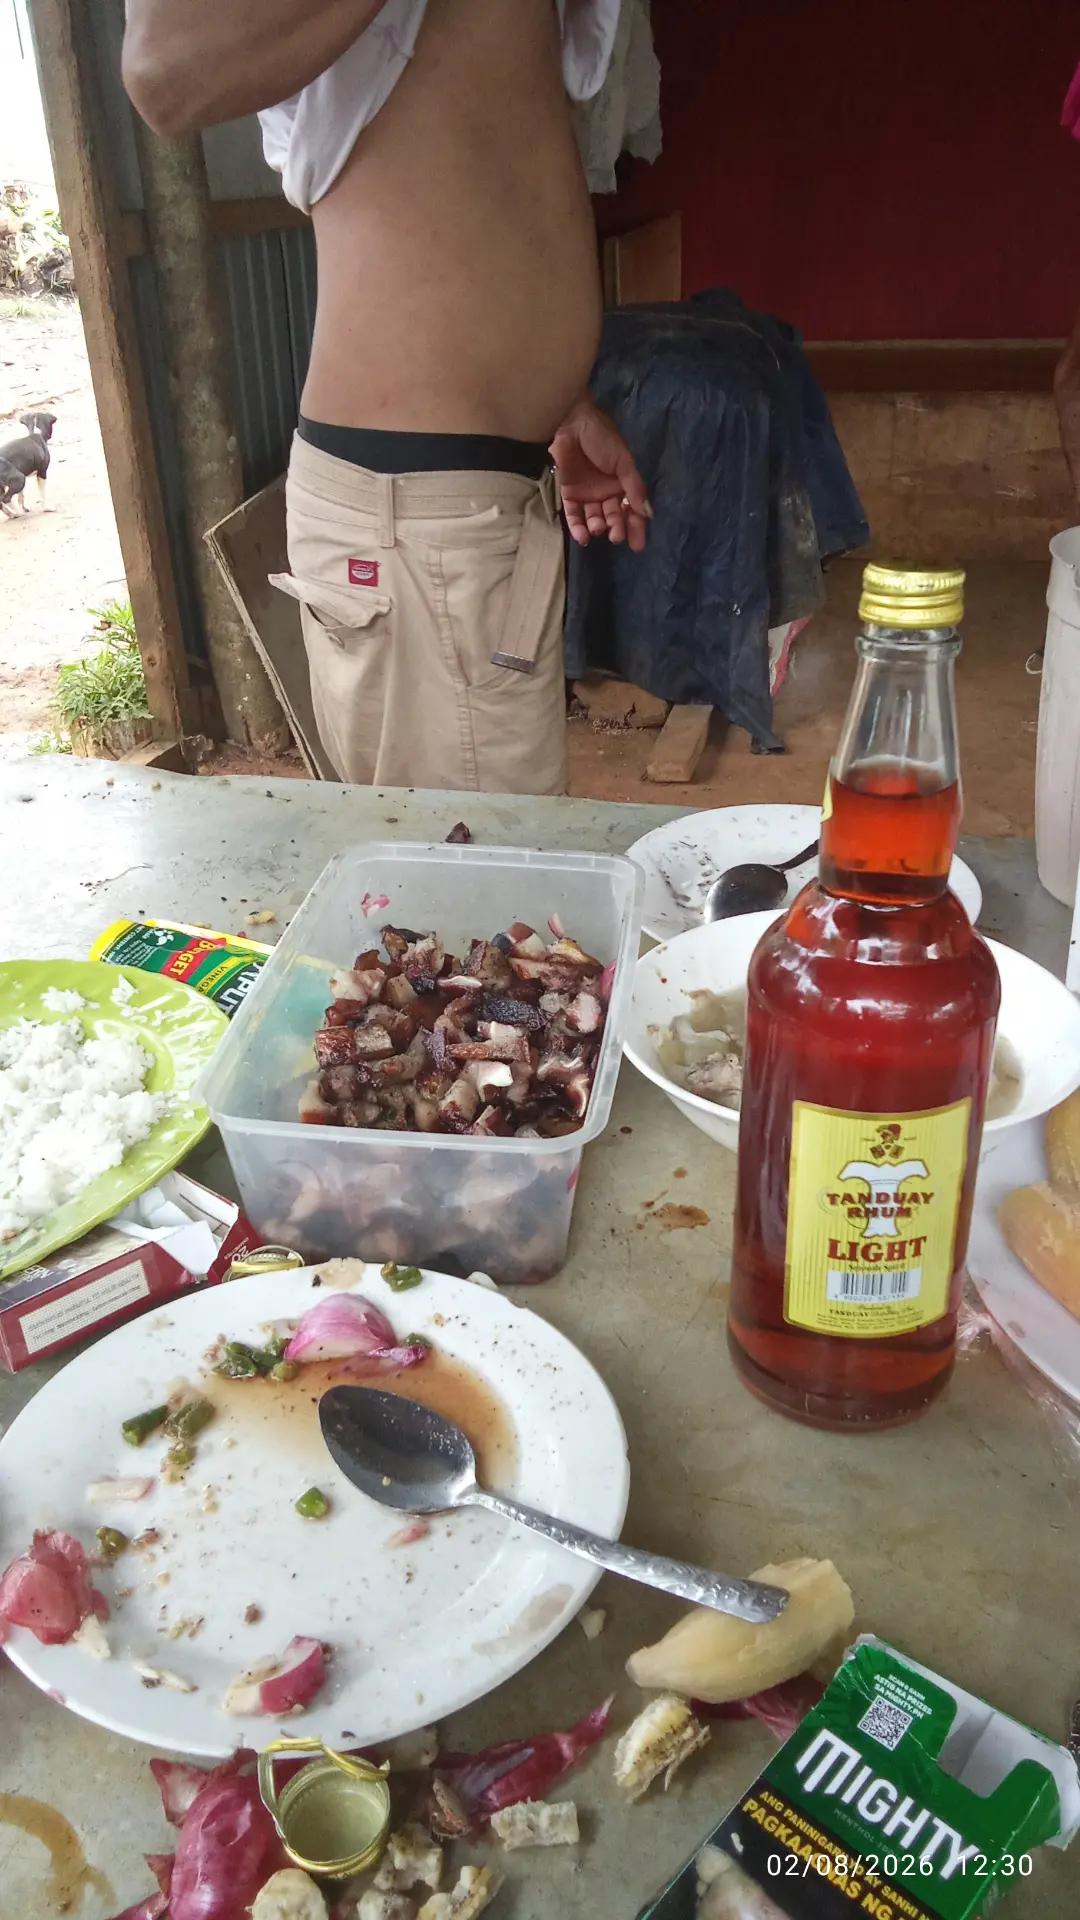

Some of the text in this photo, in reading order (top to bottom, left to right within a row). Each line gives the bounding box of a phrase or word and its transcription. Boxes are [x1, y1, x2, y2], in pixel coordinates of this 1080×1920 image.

[198, 966, 229, 993] VINEGA
[826, 1192, 934, 1206] TANDUAY
[847, 1206, 913, 1218] RHUM
[827, 1236, 928, 1263] LIGHT
[906, 1695, 933, 1715] PRIZES
[795, 1728, 981, 1881] MIGHTY
[759, 1791, 784, 1812] ANG
[881, 1885, 919, 1917] SANHI
[861, 1892, 893, 1920] NG
